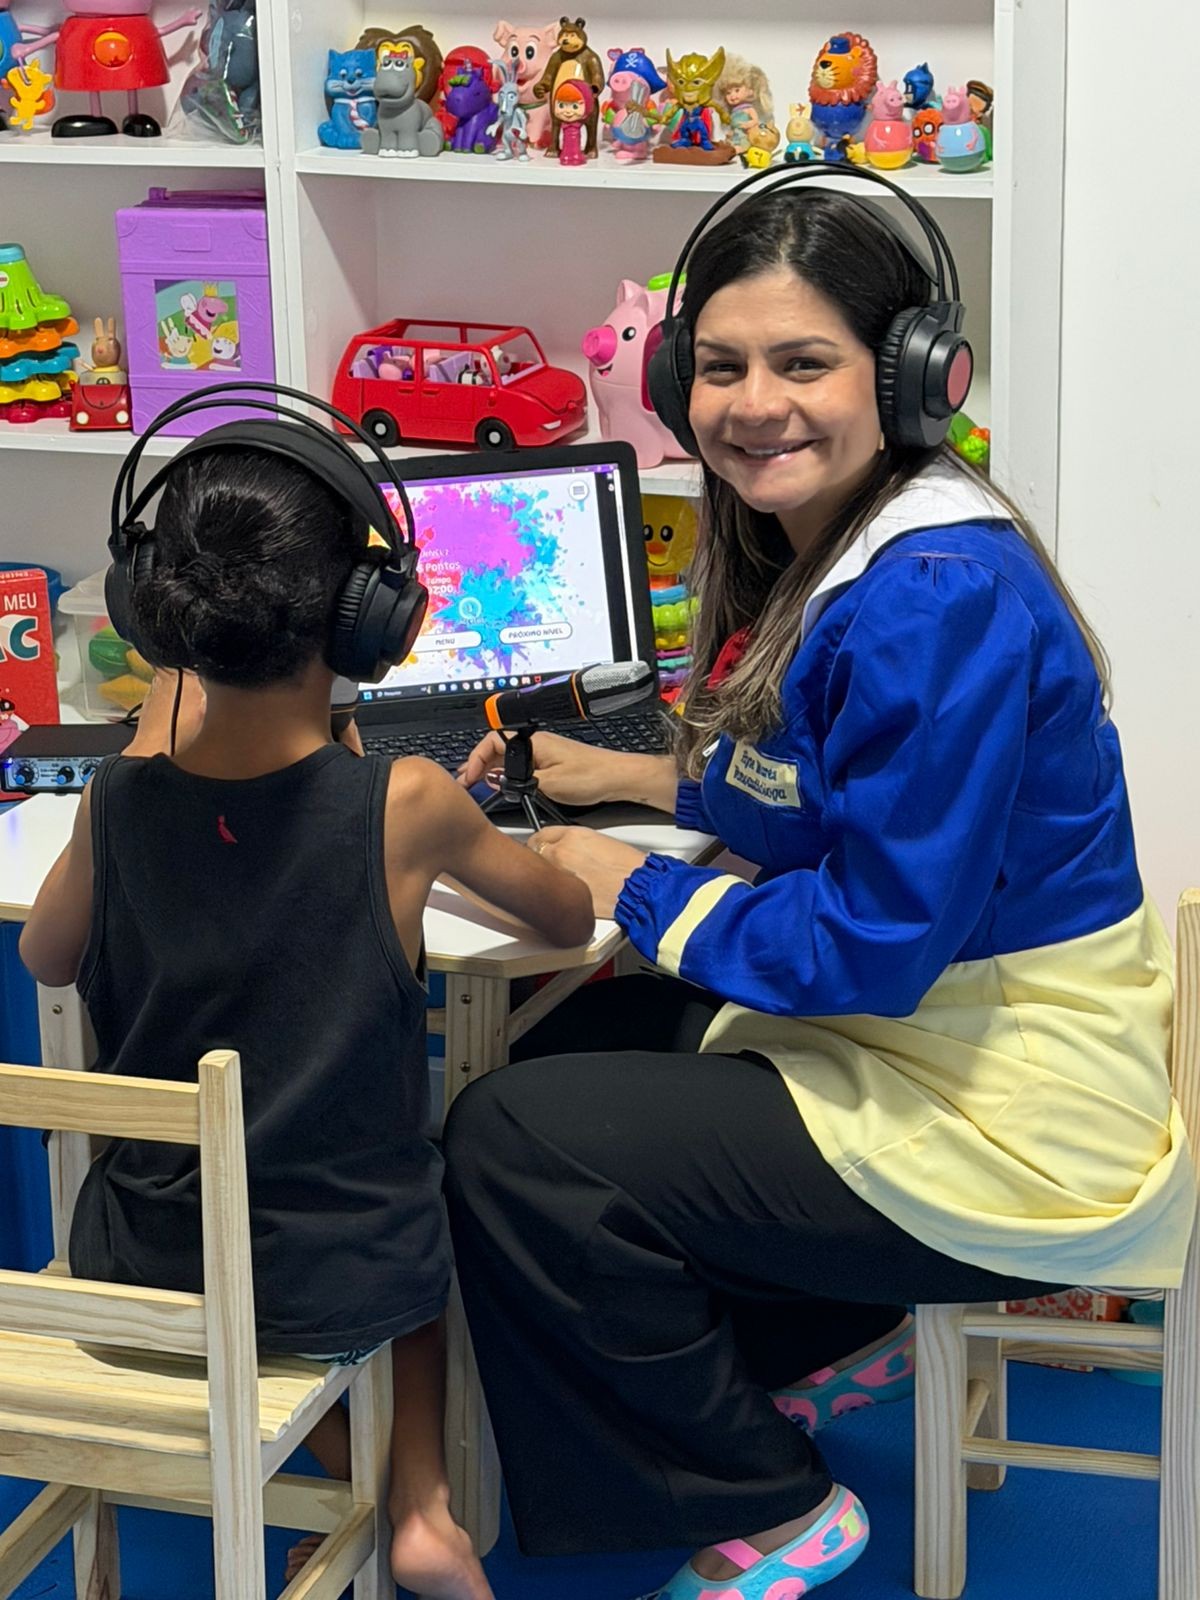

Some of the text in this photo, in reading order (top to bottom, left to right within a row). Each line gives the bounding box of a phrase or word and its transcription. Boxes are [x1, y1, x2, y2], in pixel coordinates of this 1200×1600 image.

[425, 561, 461, 572] Pontos
[4, 592, 37, 611] MEU
[0, 616, 41, 662] C
[508, 627, 563, 639] PRÓXIMO NÍVEL
[435, 638, 456, 646] MENU
